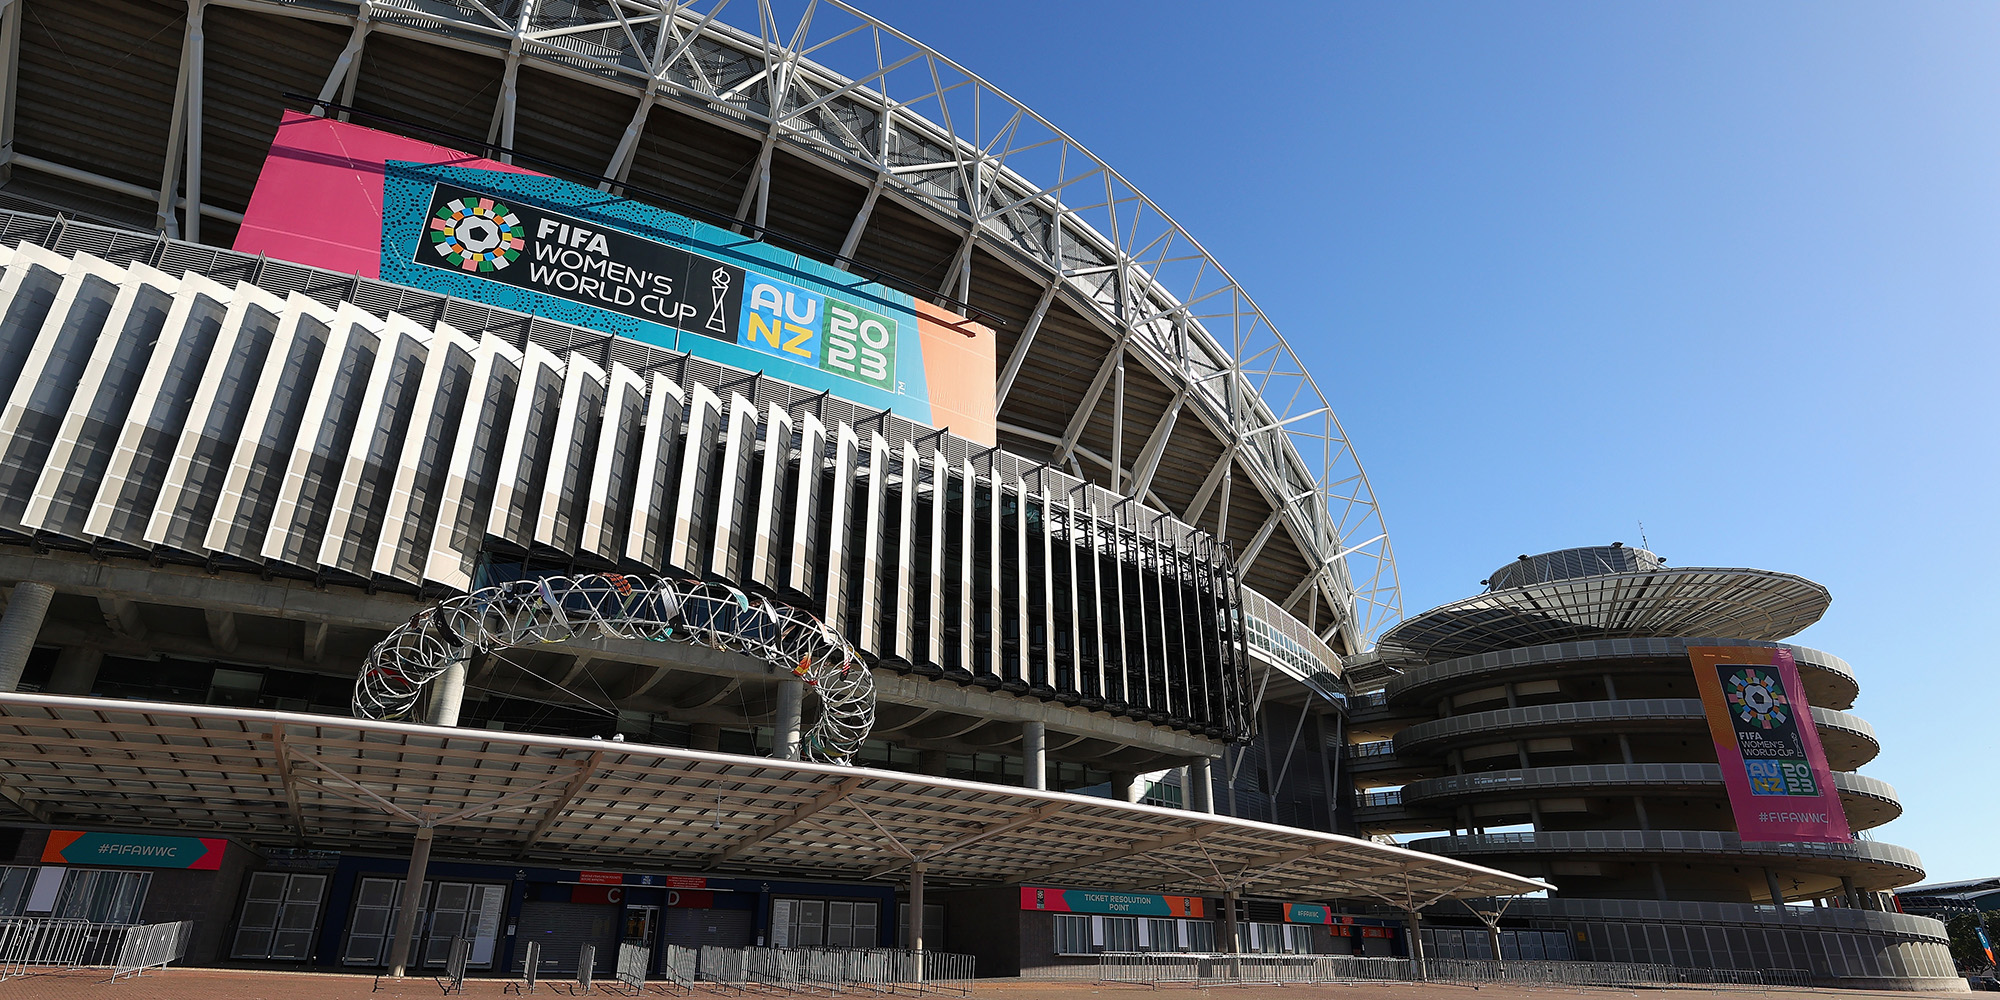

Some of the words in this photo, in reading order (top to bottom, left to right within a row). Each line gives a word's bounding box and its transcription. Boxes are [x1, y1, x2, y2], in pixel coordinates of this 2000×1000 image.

[537, 217, 610, 257] FIFA
[535, 241, 673, 296] WOMEN'S
[529, 262, 635, 307] WORLD
[641, 294, 697, 322] CUP
[750, 283, 816, 325] AU
[830, 306, 890, 350] 20
[747, 312, 814, 359] NZ
[828, 336, 888, 381] 23
[1738, 731, 1763, 740] FIFA
[1740, 741, 1785, 749] WOMEN'S
[1743, 748, 1777, 757] WORLD
[1777, 749, 1794, 757] CUP
[1750, 762, 1779, 777] AU
[1782, 763, 1810, 777] 20
[1753, 778, 1784, 792] NZ
[1788, 779, 1815, 793] 23
[1758, 812, 1829, 824] #FIFAWWC
[98, 843, 177, 857] #FIFAWWC
[607, 887, 622, 904] C
[667, 891, 680, 906] D
[1084, 893, 1109, 903] TICKET
[1110, 895, 1152, 905] RESOLUTION
[1109, 903, 1130, 912] POINT
